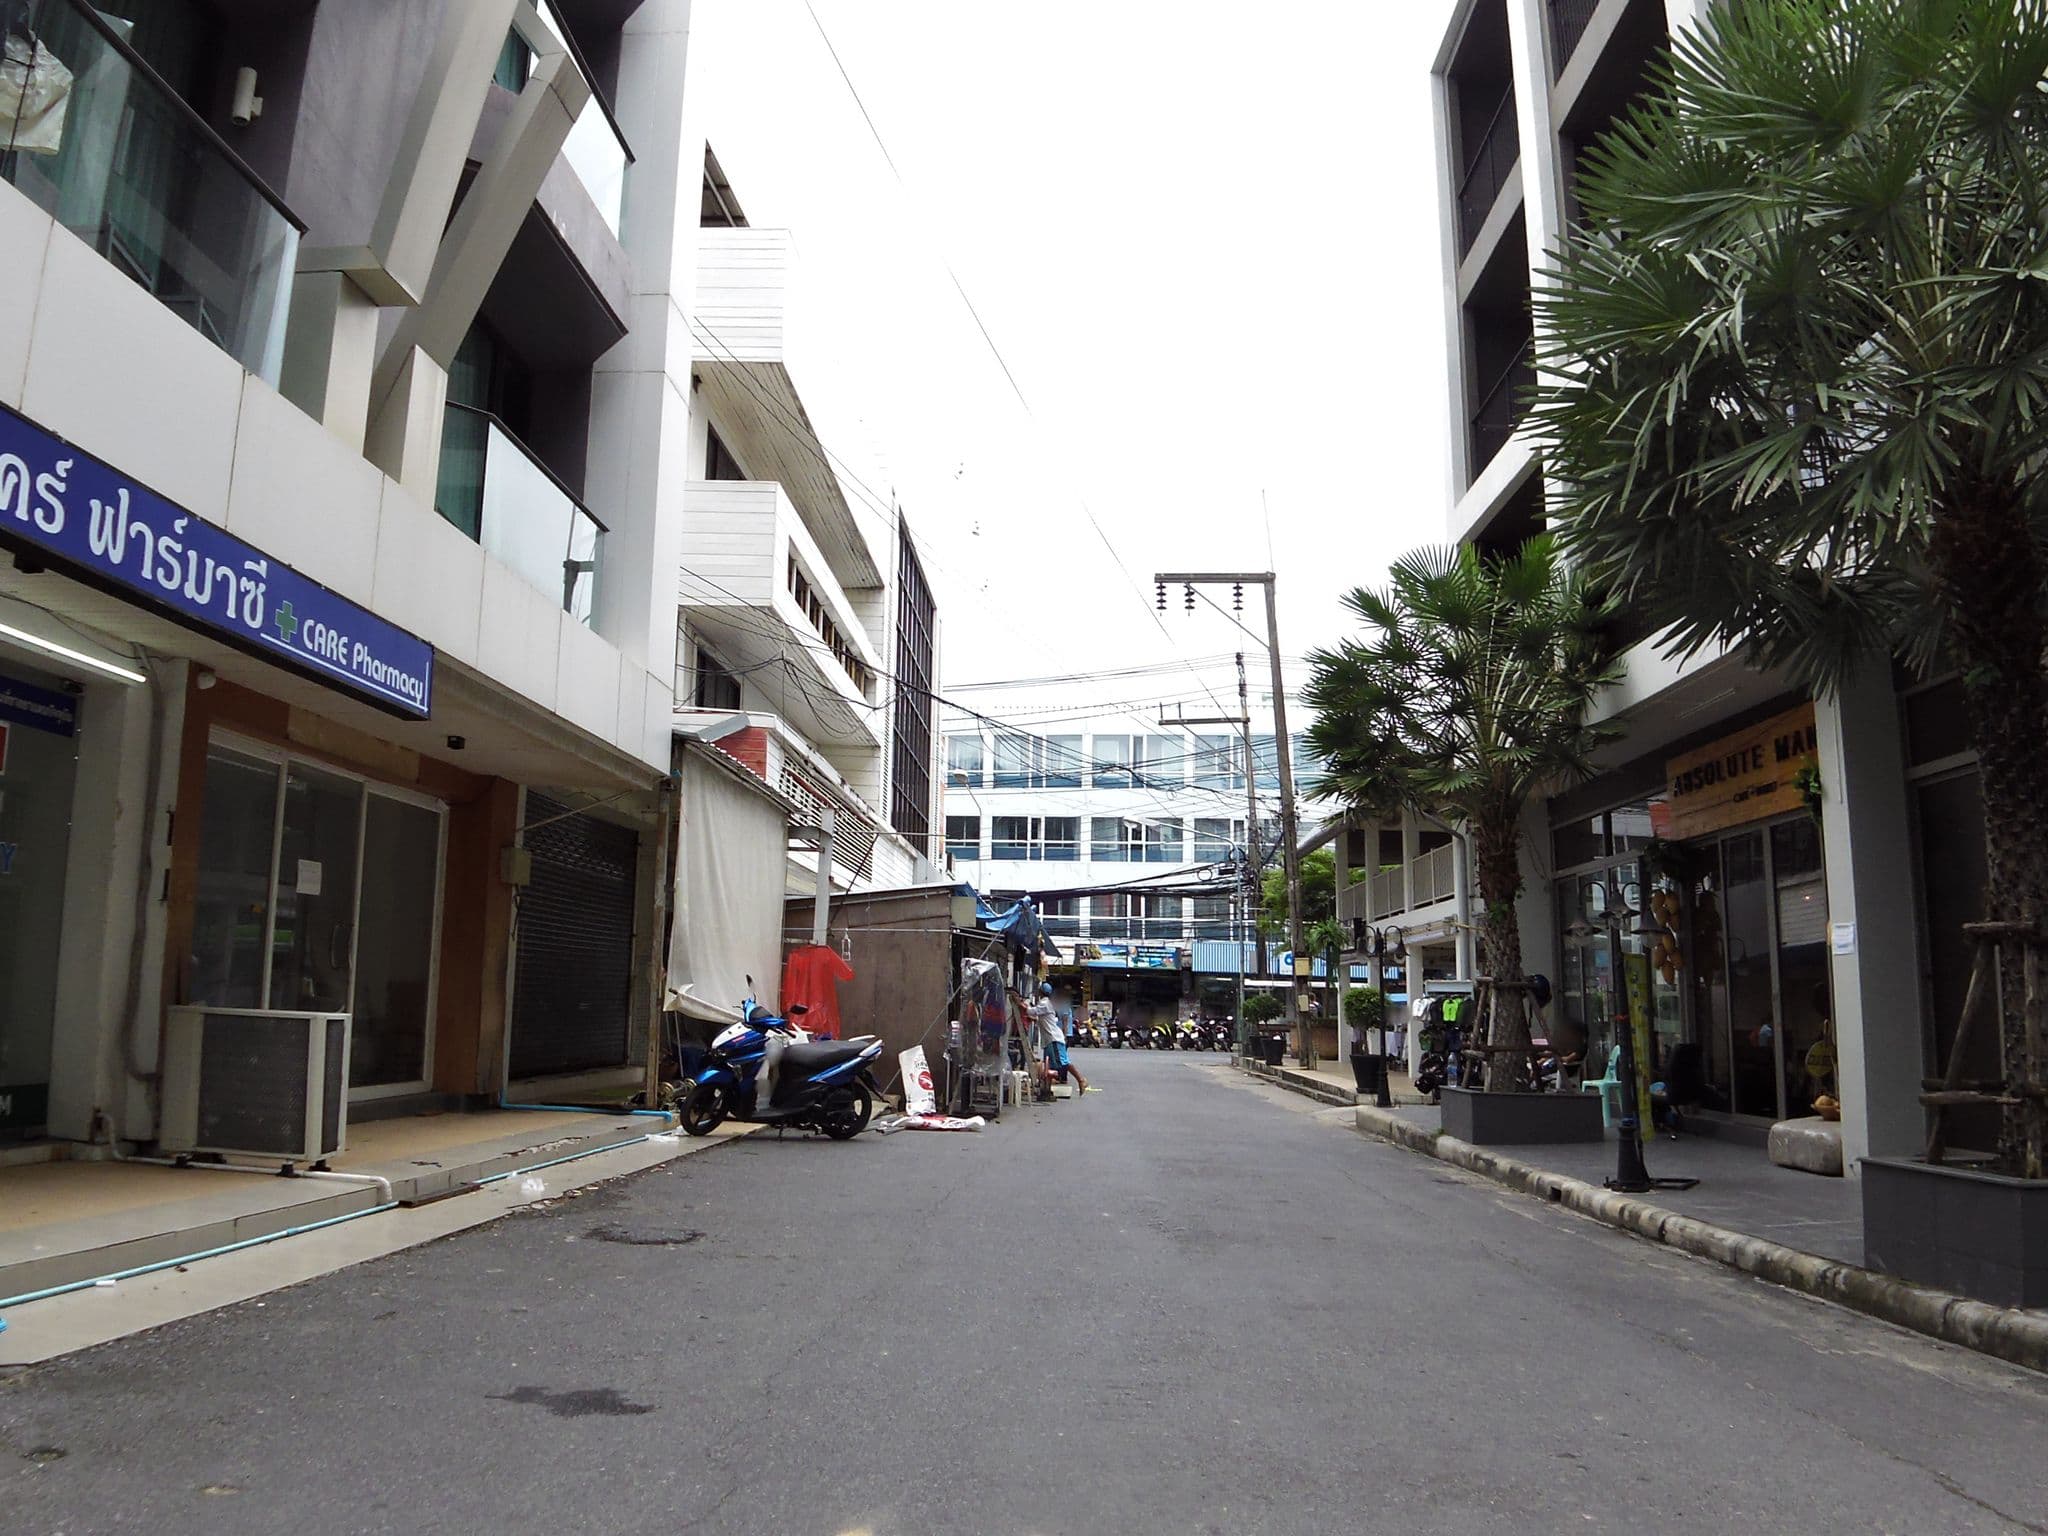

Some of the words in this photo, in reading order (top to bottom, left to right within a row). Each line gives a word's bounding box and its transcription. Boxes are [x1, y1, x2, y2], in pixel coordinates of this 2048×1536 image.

[89, 487, 268, 630] ฟาร์มาซี
[303, 619, 348, 664] CARE
[352, 643, 424, 702] Pharmacy
[1673, 745, 1764, 797] ABSOLUTE
